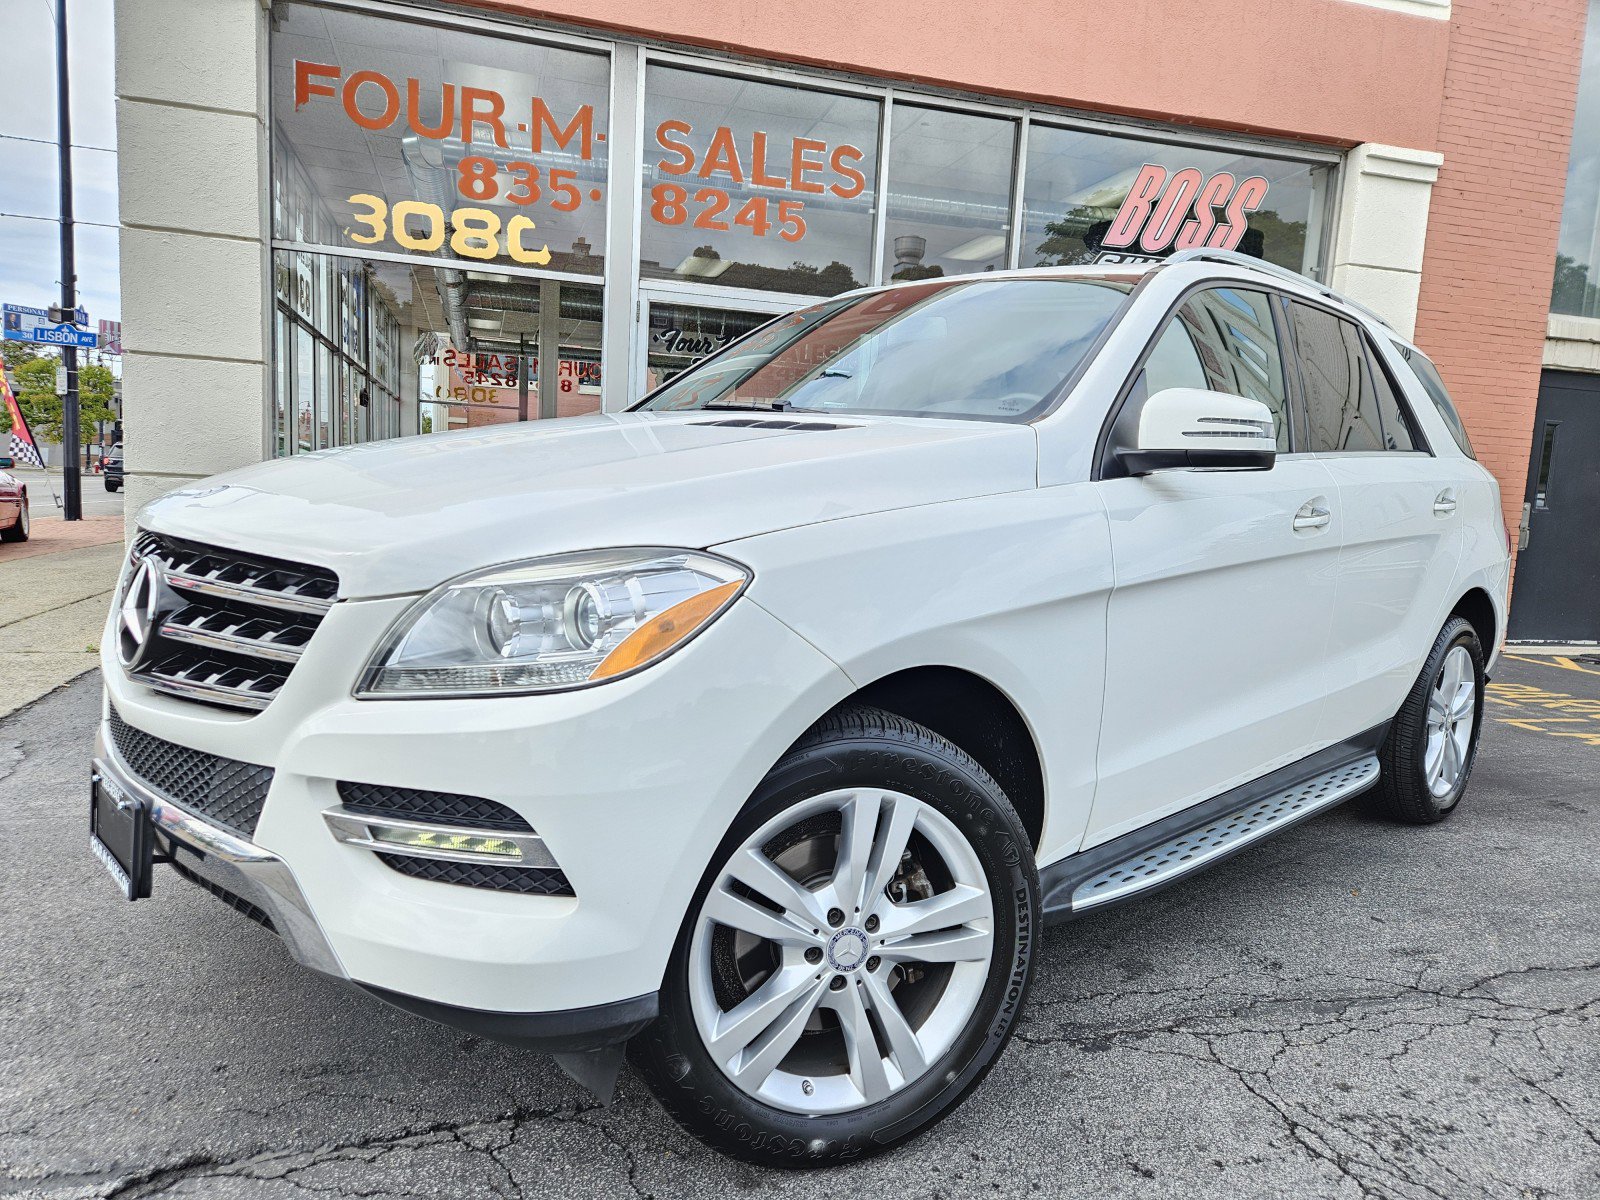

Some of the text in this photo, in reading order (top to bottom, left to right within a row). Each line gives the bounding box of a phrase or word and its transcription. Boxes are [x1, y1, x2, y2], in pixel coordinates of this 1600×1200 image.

[655, 119, 866, 200] SALES
[650, 182, 807, 243] 8245
[1101, 162, 1269, 252] BOSS
[37, 329, 78, 344] LISBON
[660, 327, 713, 355] Four
[1002, 887, 1030, 1015] DESTINATION
